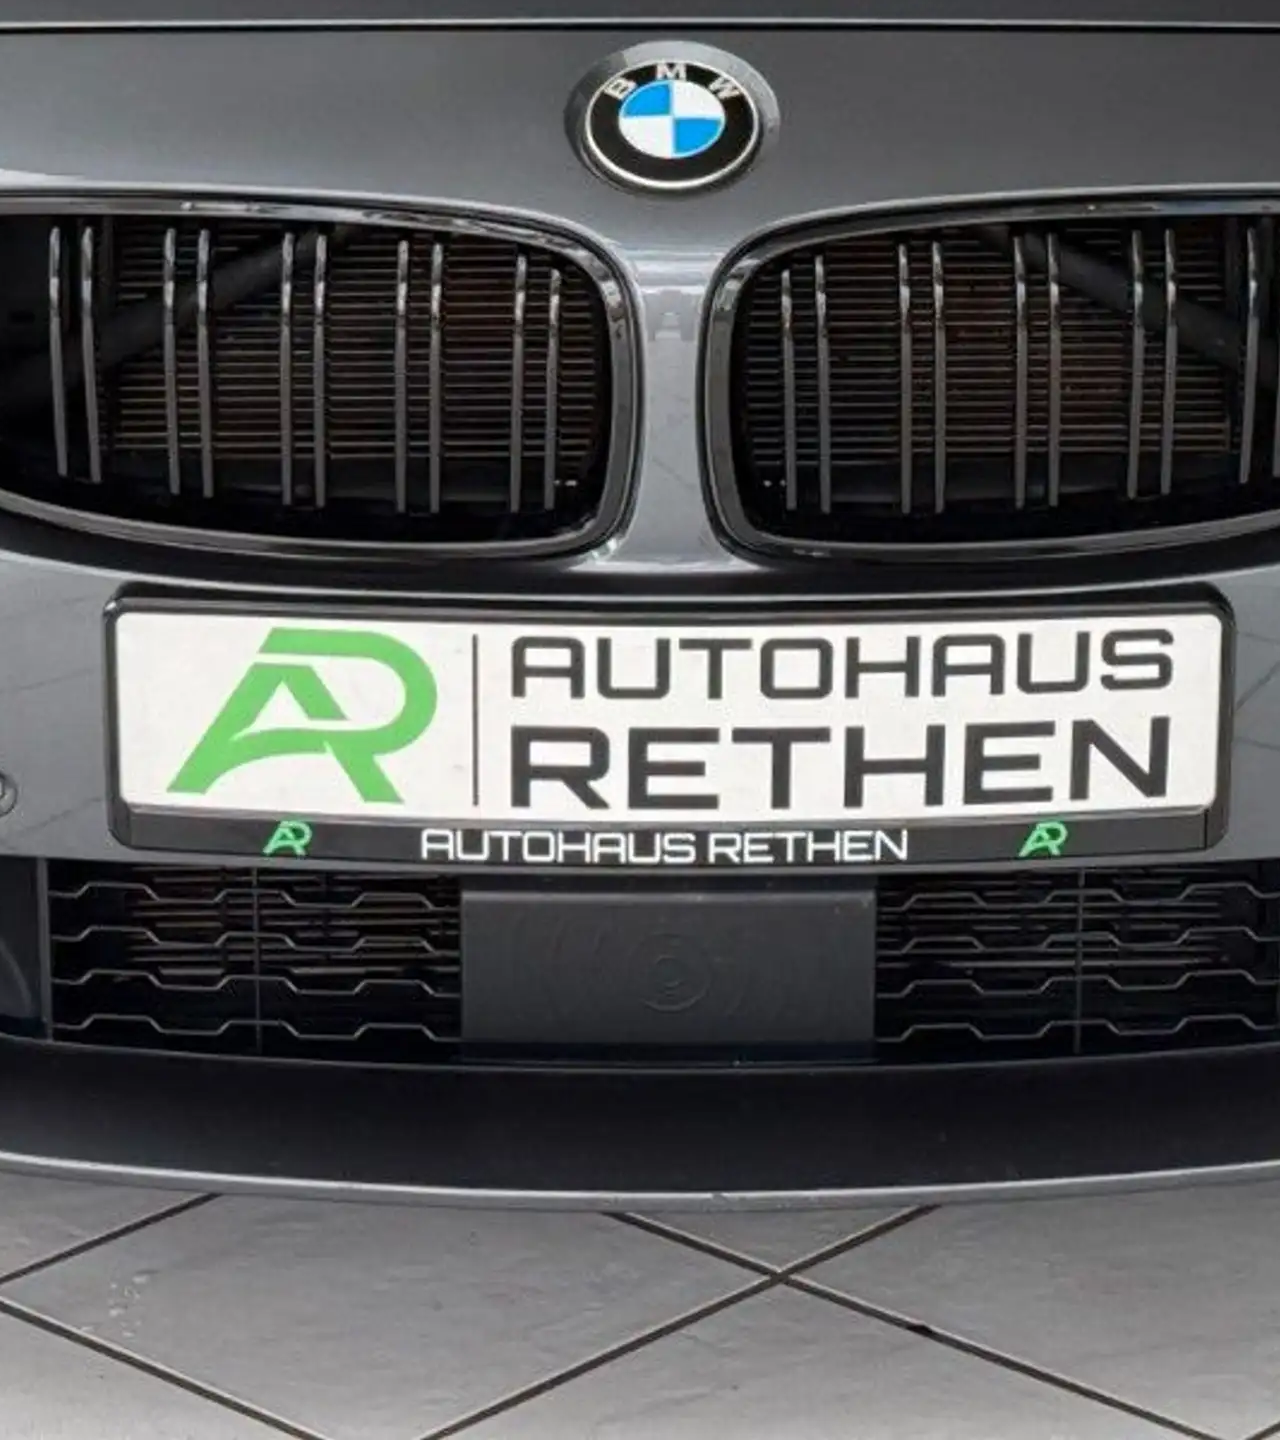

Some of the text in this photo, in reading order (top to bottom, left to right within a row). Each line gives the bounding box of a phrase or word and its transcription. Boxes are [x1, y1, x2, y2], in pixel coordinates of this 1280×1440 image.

[604, 62, 741, 100] BMW
[511, 628, 1174, 700] AUTOHAUS
[511, 716, 1171, 810] RETHEN
[421, 828, 908, 864] AUTOHAUS RETHEN
